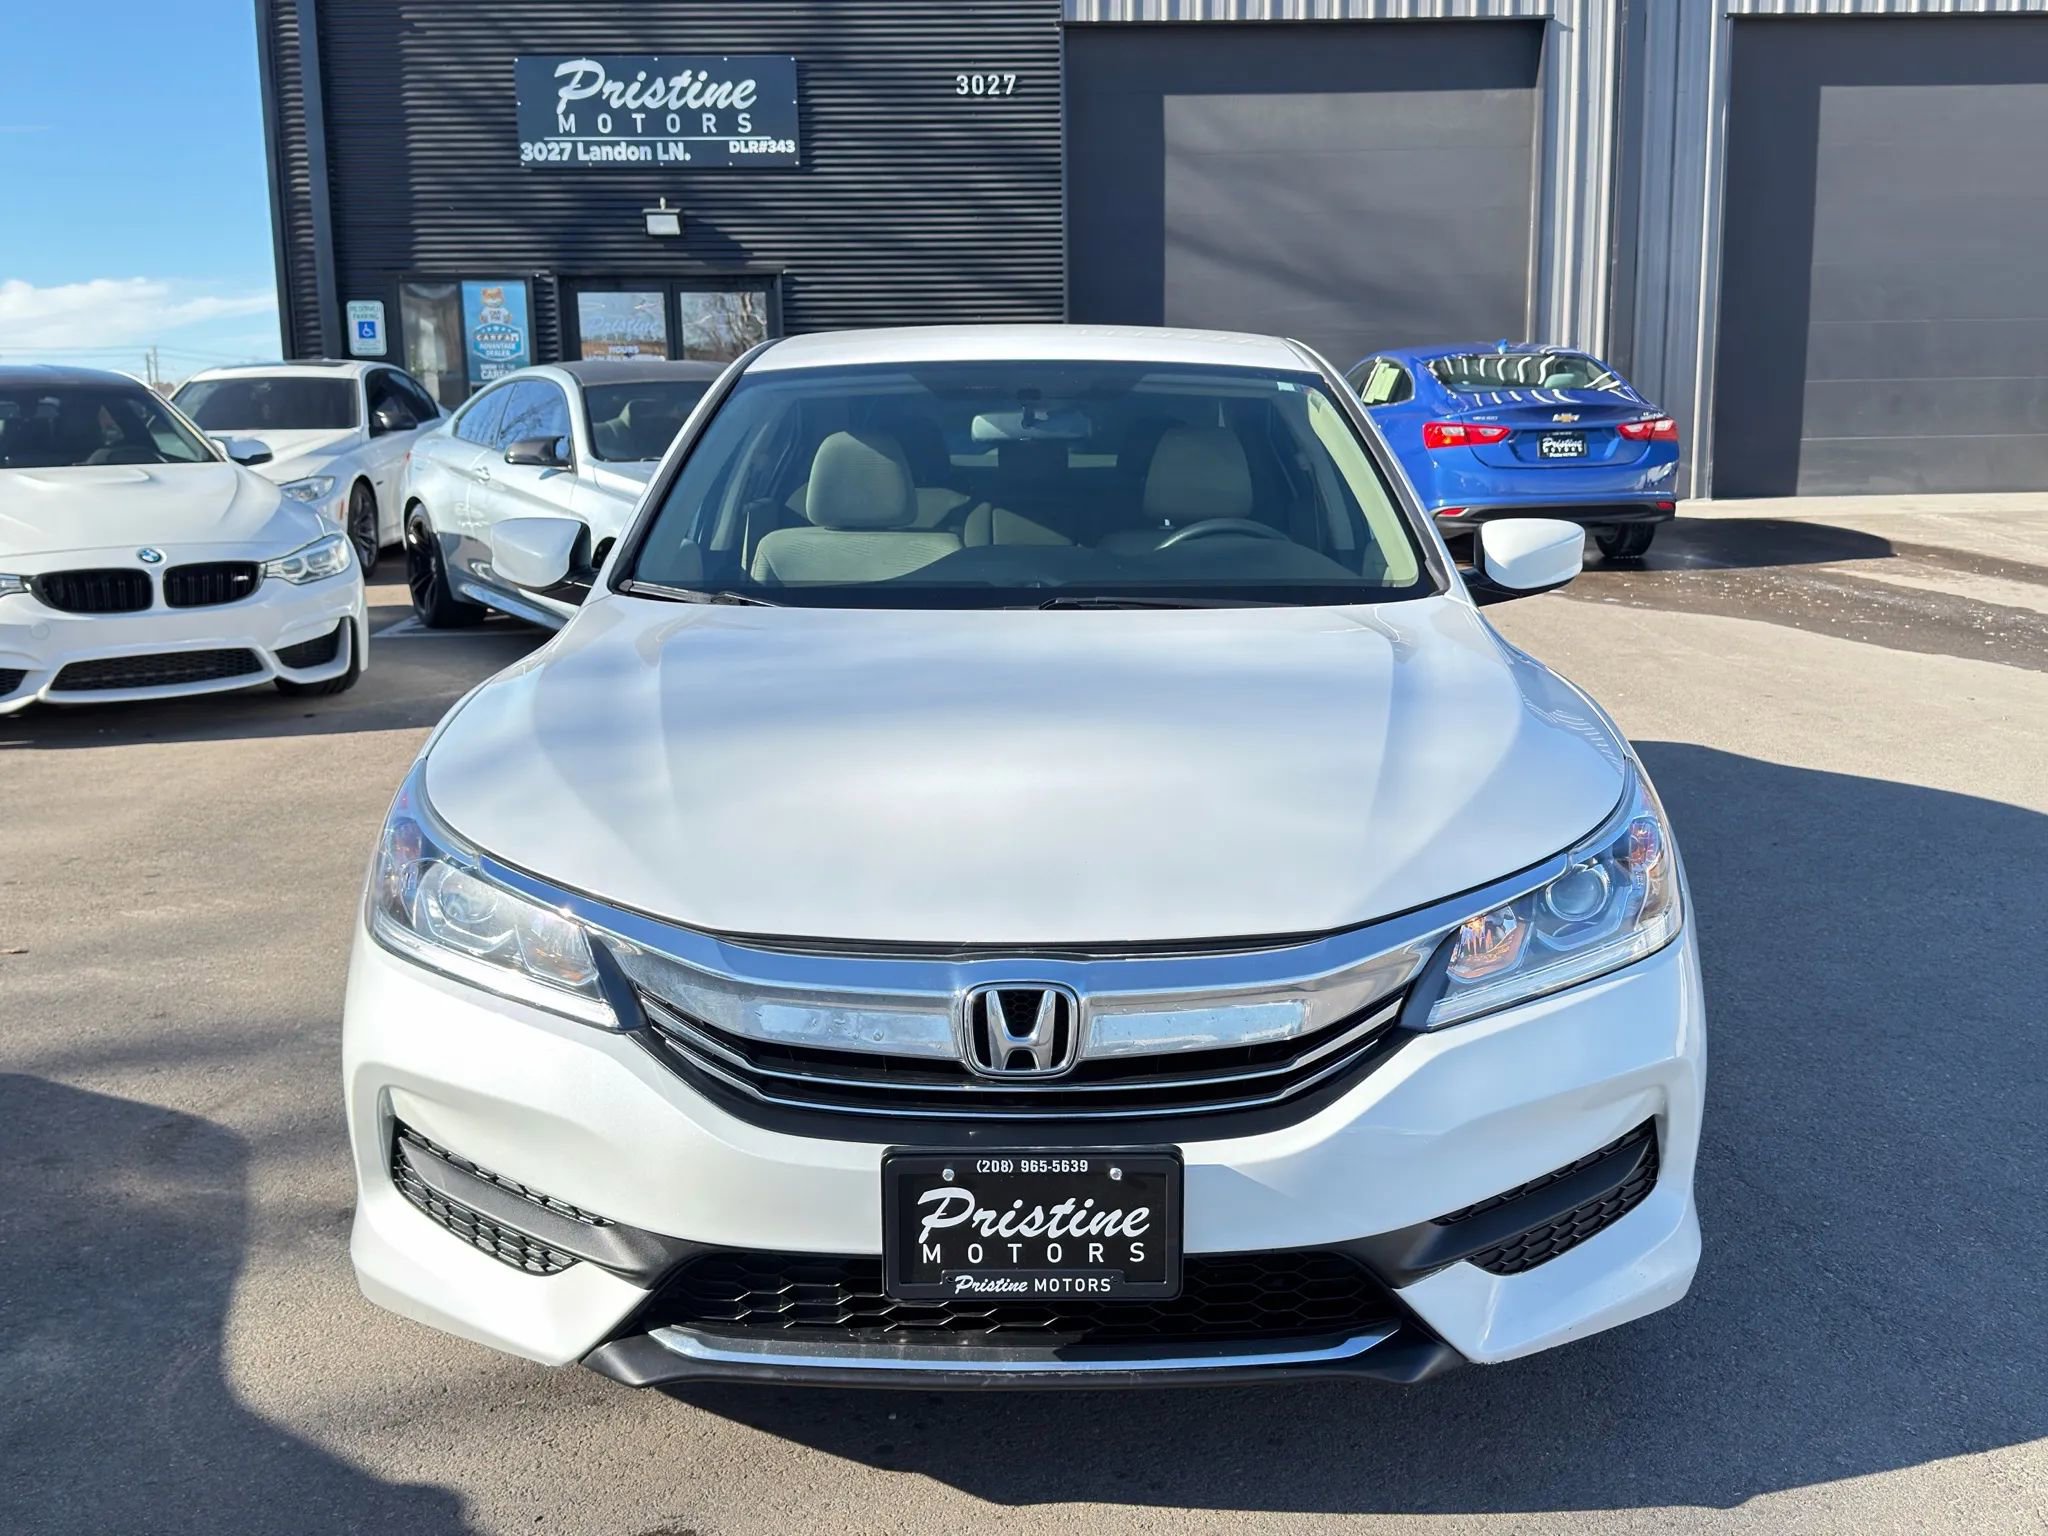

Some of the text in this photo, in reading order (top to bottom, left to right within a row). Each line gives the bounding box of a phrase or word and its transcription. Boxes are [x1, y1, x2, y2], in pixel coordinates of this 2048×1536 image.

[554, 59, 757, 114] Pristine
[956, 74, 1016, 95] 3027
[558, 113, 753, 134] MOTORS
[520, 142, 691, 161] 3027 Landon LN.
[729, 140, 796, 153] DLR#343
[976, 1159, 1089, 1174] (208) 965-5639
[917, 1186, 1151, 1244] Pristine
[922, 1243, 1146, 1264] MOTORS
[955, 1275, 1111, 1294] Pristine MOTORS
